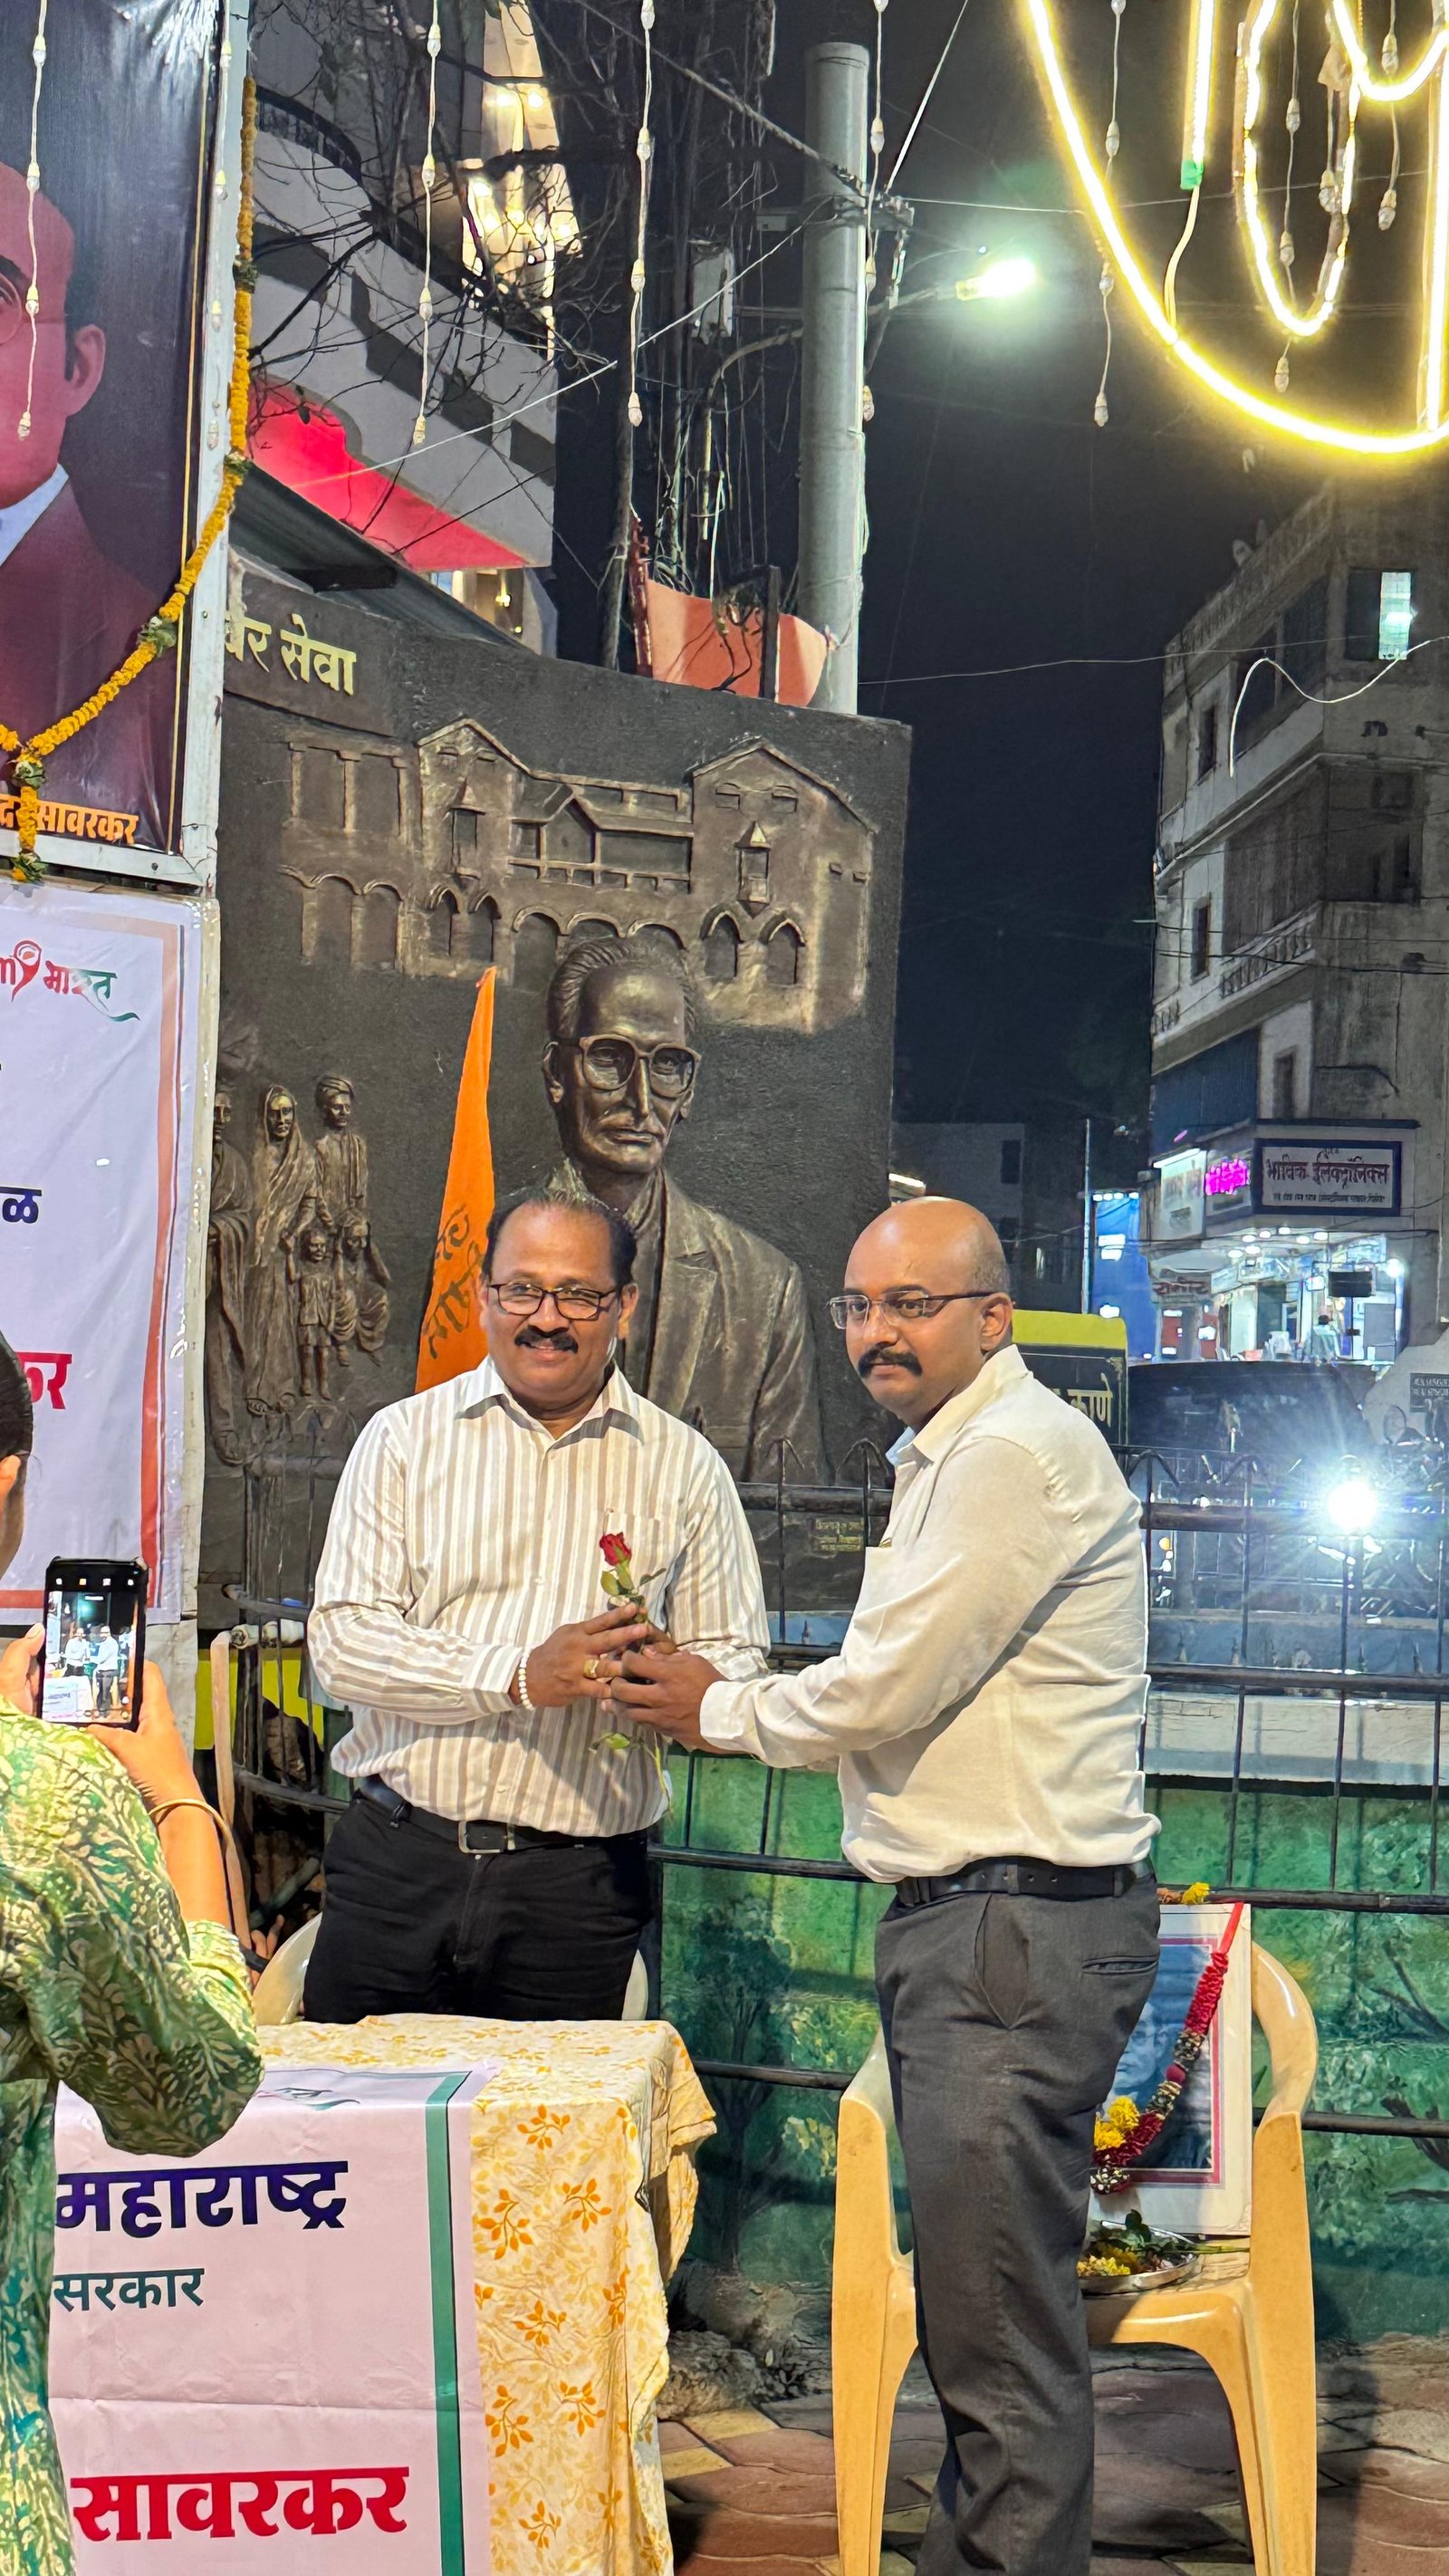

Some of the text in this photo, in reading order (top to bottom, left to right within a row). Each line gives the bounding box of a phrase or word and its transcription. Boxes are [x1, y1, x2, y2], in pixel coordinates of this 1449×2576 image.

[280, 612, 357, 696] सेवा
[35, 799, 139, 845] सावरकर
[55, 2161, 349, 2238] महाराष्ट्र
[53, 2268, 205, 2312] सरकार
[71, 2467, 409, 2542] सावरकर
